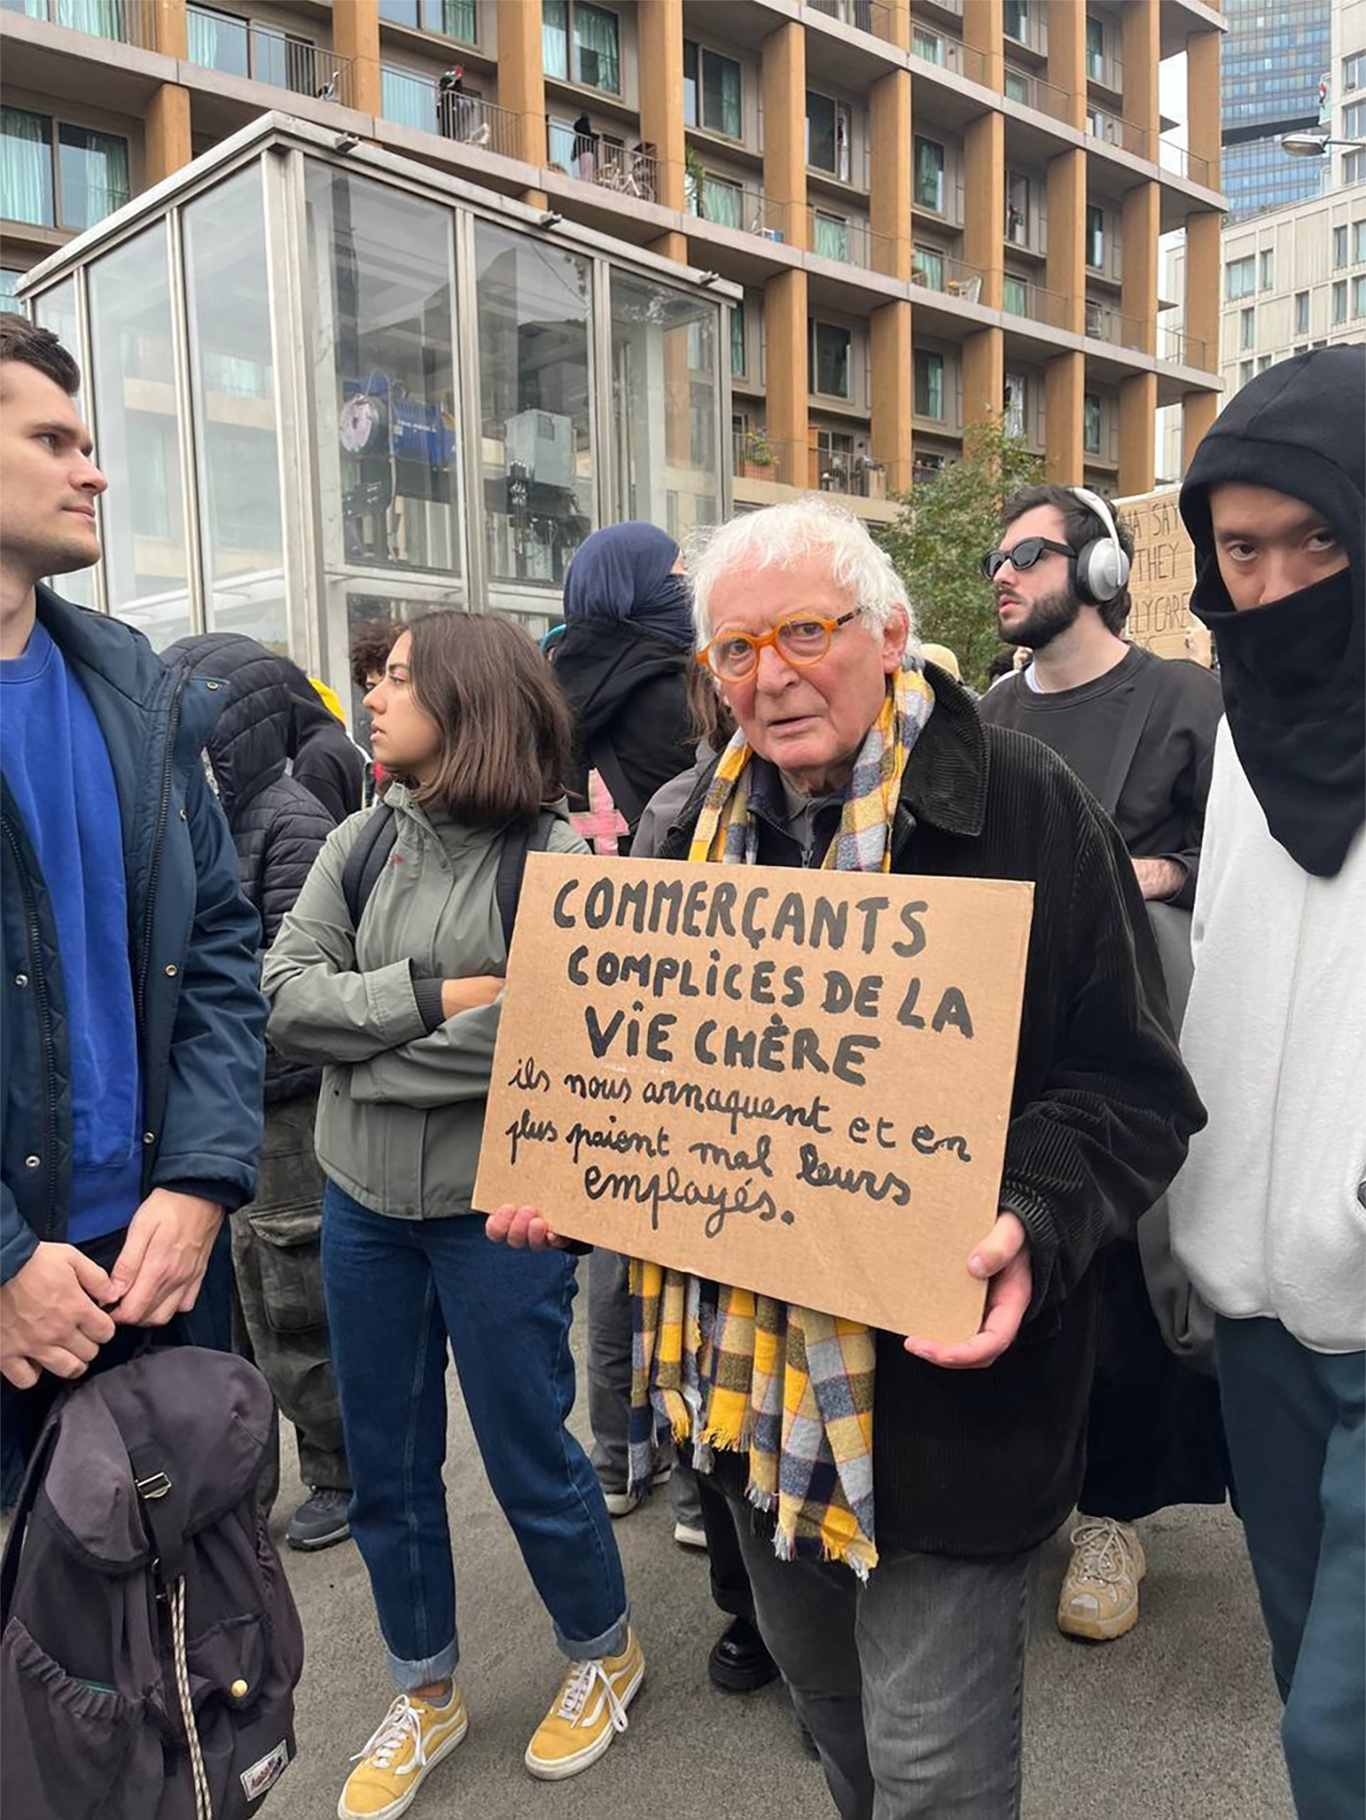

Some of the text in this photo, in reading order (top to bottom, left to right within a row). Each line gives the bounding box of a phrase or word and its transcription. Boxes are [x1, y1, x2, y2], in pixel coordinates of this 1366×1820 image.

[1135, 542, 1180, 582] THEY
[553, 877, 928, 956] COMMERÇANTS
[820, 970, 884, 1018] DE
[897, 977, 974, 1039] LA
[694, 1013, 881, 1086] CHÈRE
[508, 1057, 972, 1162] ils nous arnaquent et en
[506, 1108, 558, 1165] plus
[688, 1134, 774, 1177] mal
[796, 1143, 911, 1206] leurs
